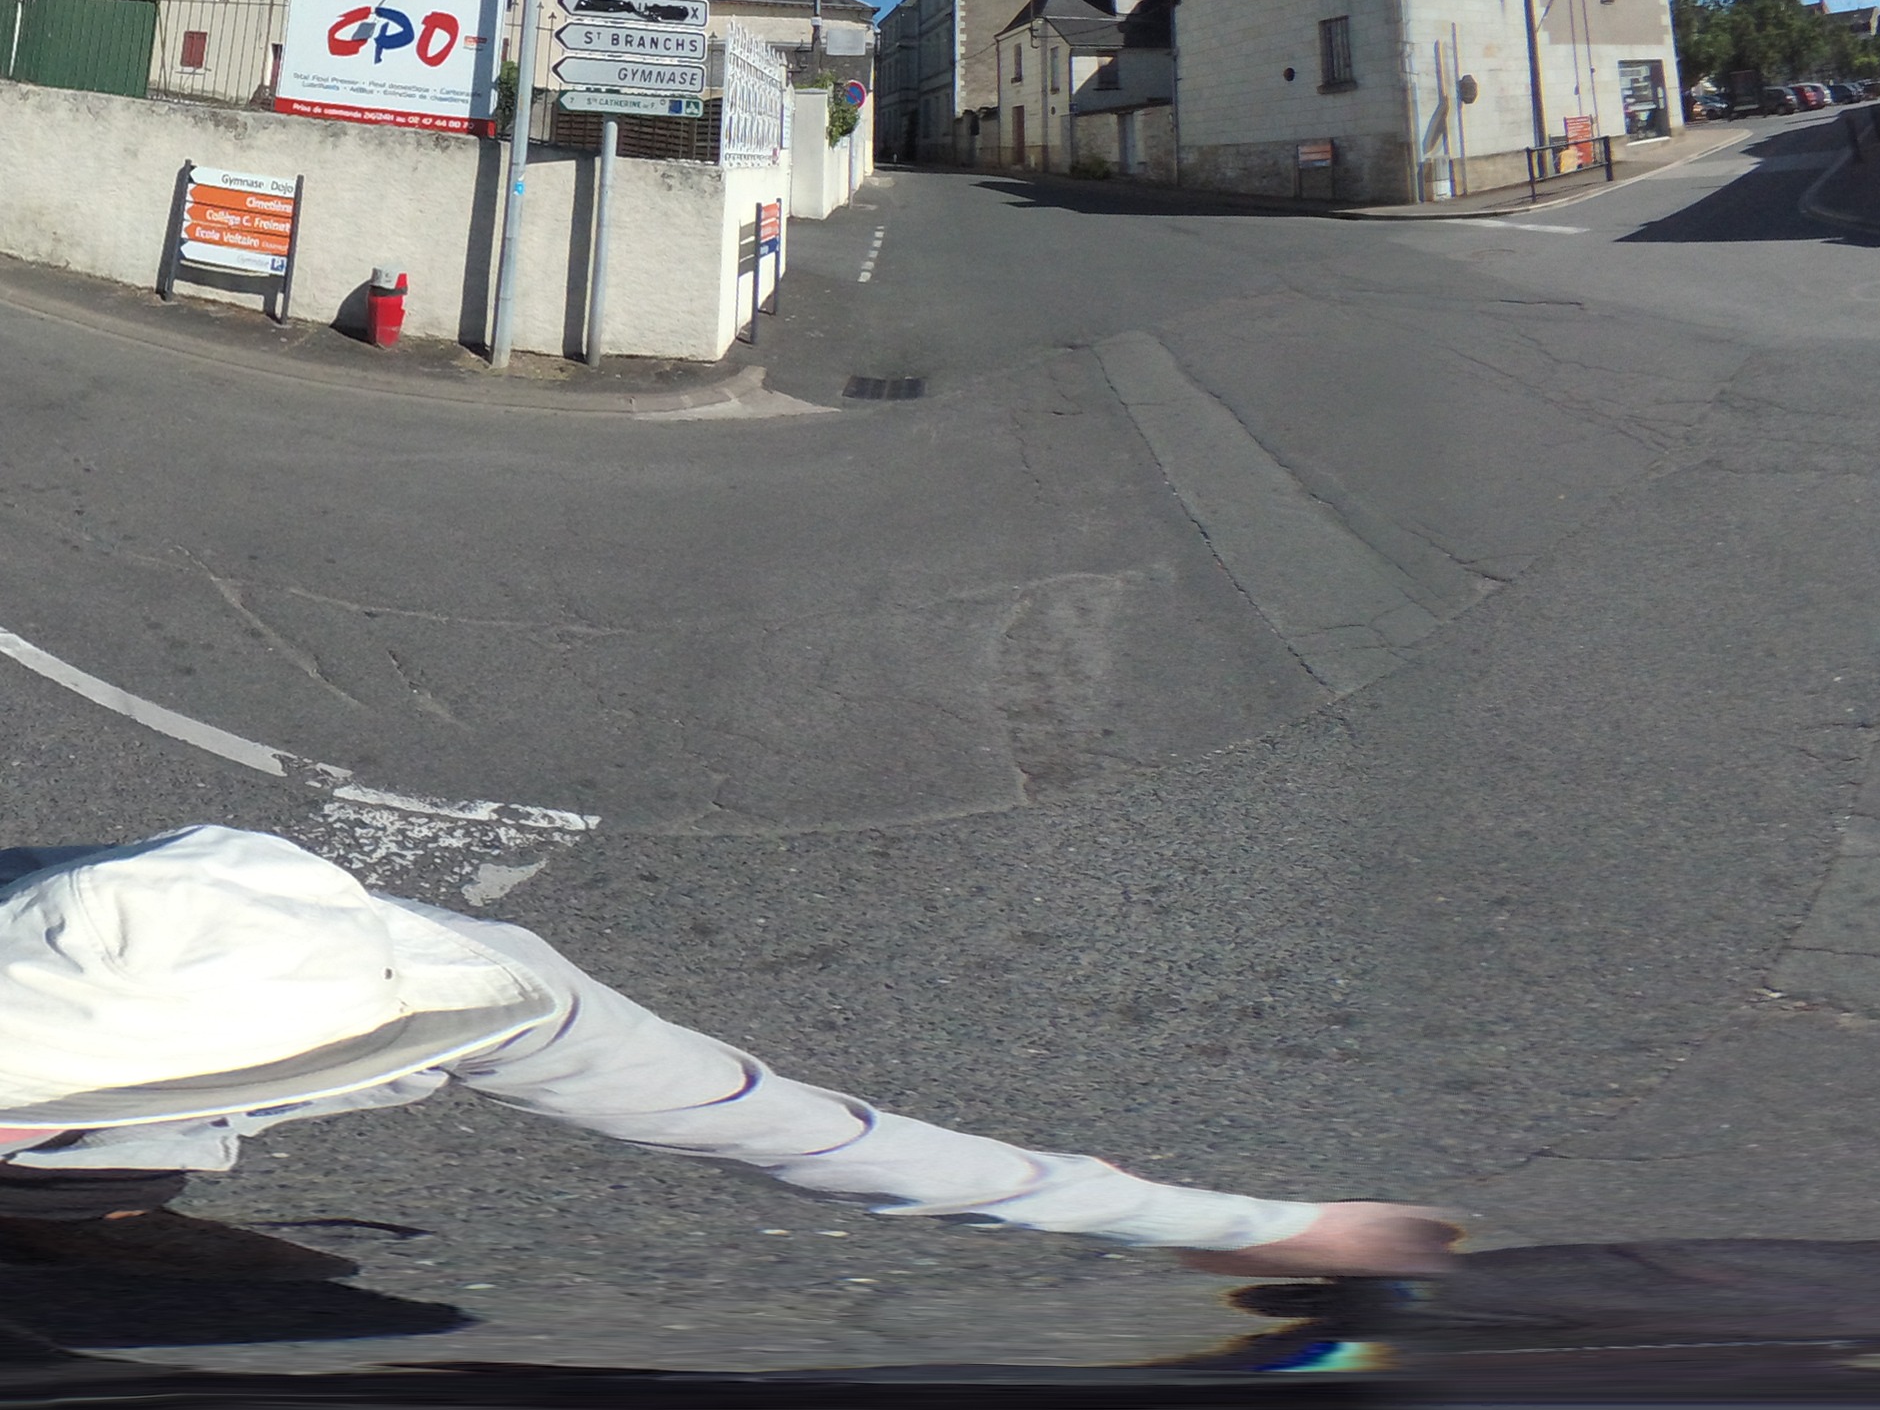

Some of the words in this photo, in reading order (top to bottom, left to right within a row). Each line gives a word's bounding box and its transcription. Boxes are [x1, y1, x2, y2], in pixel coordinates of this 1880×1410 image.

[611, 33, 698, 53] BRANCHS
[618, 67, 698, 87] GYMNASE
[221, 173, 265, 189] Gymnase
[270, 180, 294, 195] Dojo
